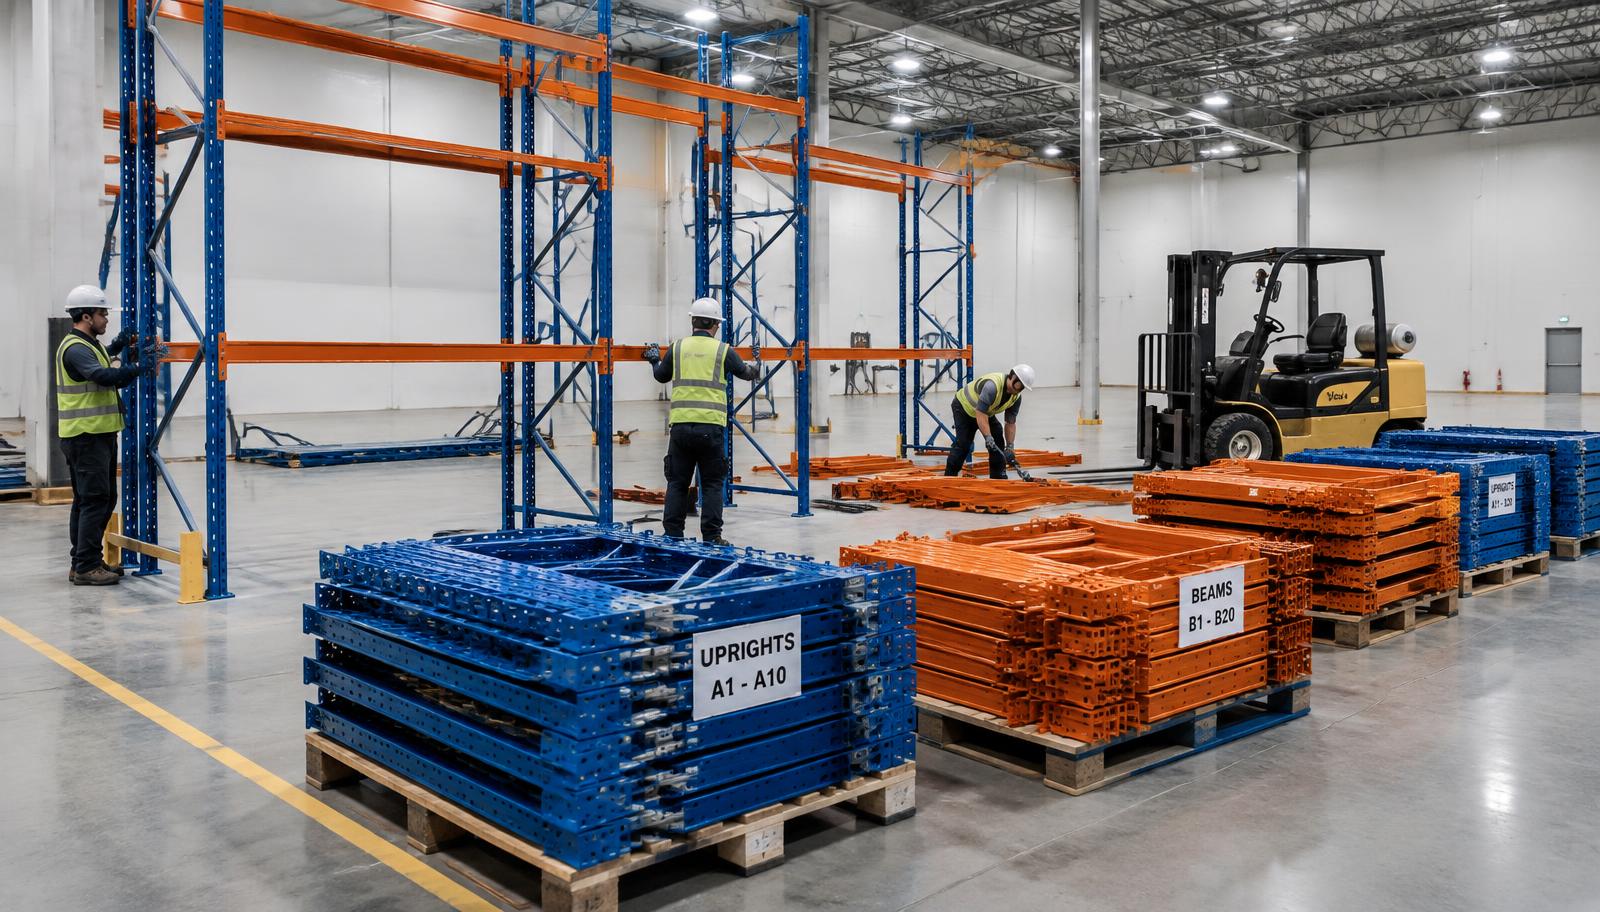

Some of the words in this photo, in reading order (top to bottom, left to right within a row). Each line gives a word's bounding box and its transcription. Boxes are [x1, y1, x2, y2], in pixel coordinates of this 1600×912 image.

[1192, 581, 1232, 604] BEAMS
[1189, 614, 1202, 632] B1
[1215, 607, 1235, 626] B20
[701, 632, 795, 667] UPRIGHTS
[711, 677, 734, 700] A1
[753, 665, 787, 691] A10
